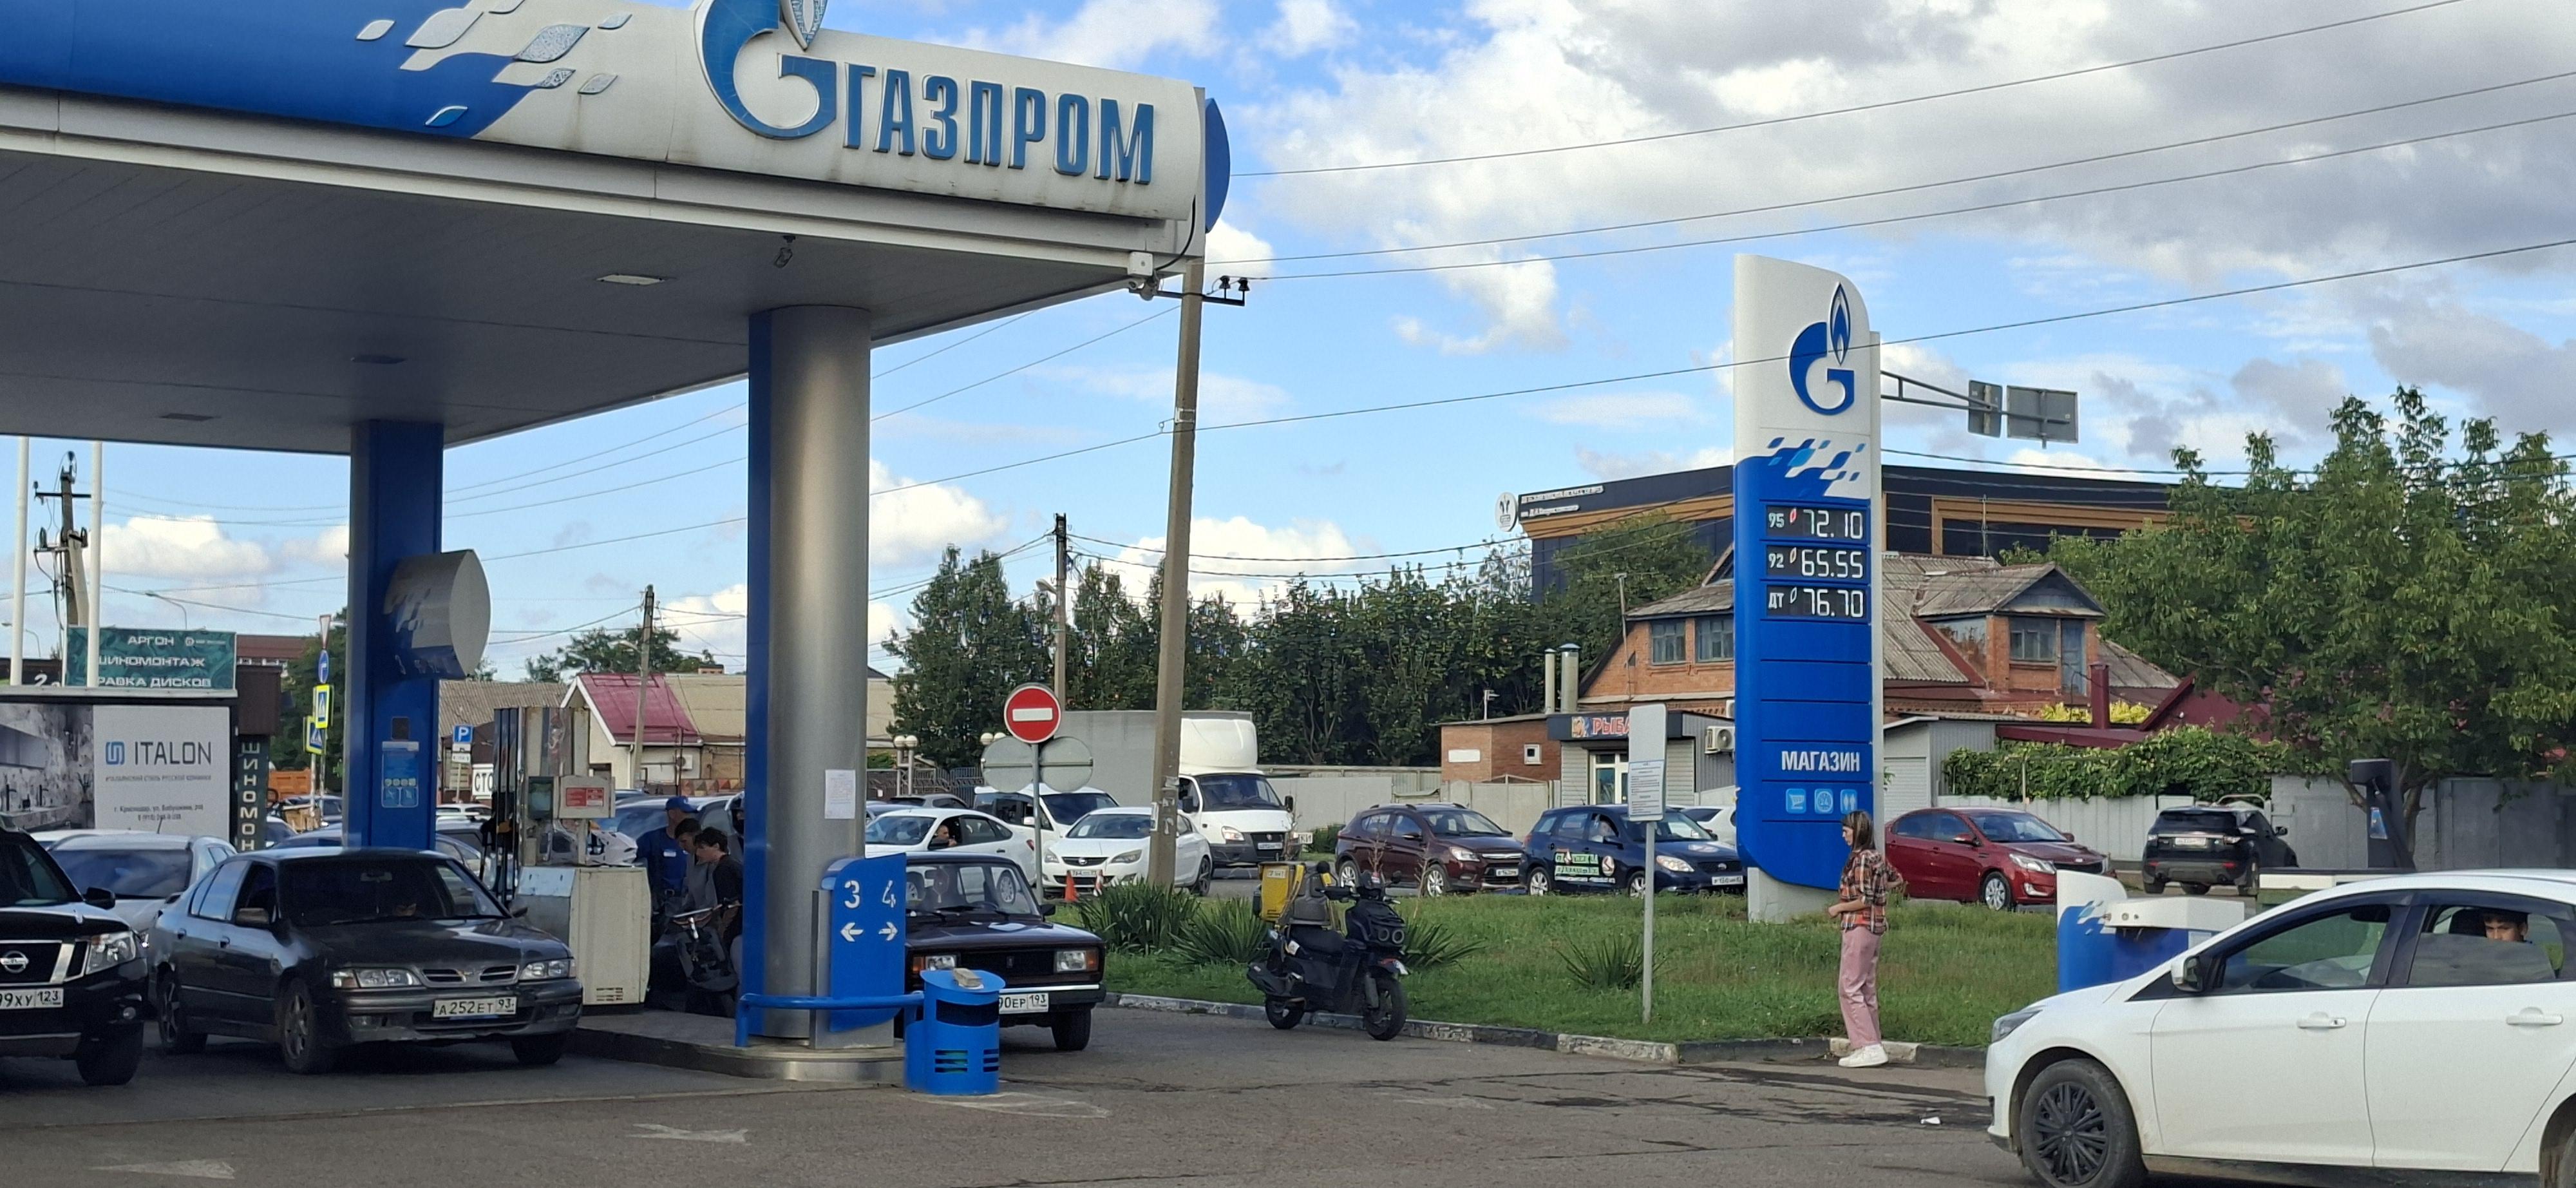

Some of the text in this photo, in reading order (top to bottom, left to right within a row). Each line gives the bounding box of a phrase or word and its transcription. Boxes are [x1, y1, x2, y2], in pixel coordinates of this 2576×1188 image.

[842, 62, 1155, 185] ГАЗПРОМ
[1768, 509, 1863, 539] 95 72.10
[1768, 550, 1863, 578] 92 65.55
[1768, 588, 1863, 618] ДТ 76.70
[128, 636, 174, 646] АРГОН
[99, 676, 211, 688] РАВКА ДИСКОВ
[135, 742, 211, 765] ITALON
[1781, 751, 1861, 772] МАГАЗИН
[844, 880, 896, 908] 3 4
[439, 1001, 495, 1015] А252ЕТ
